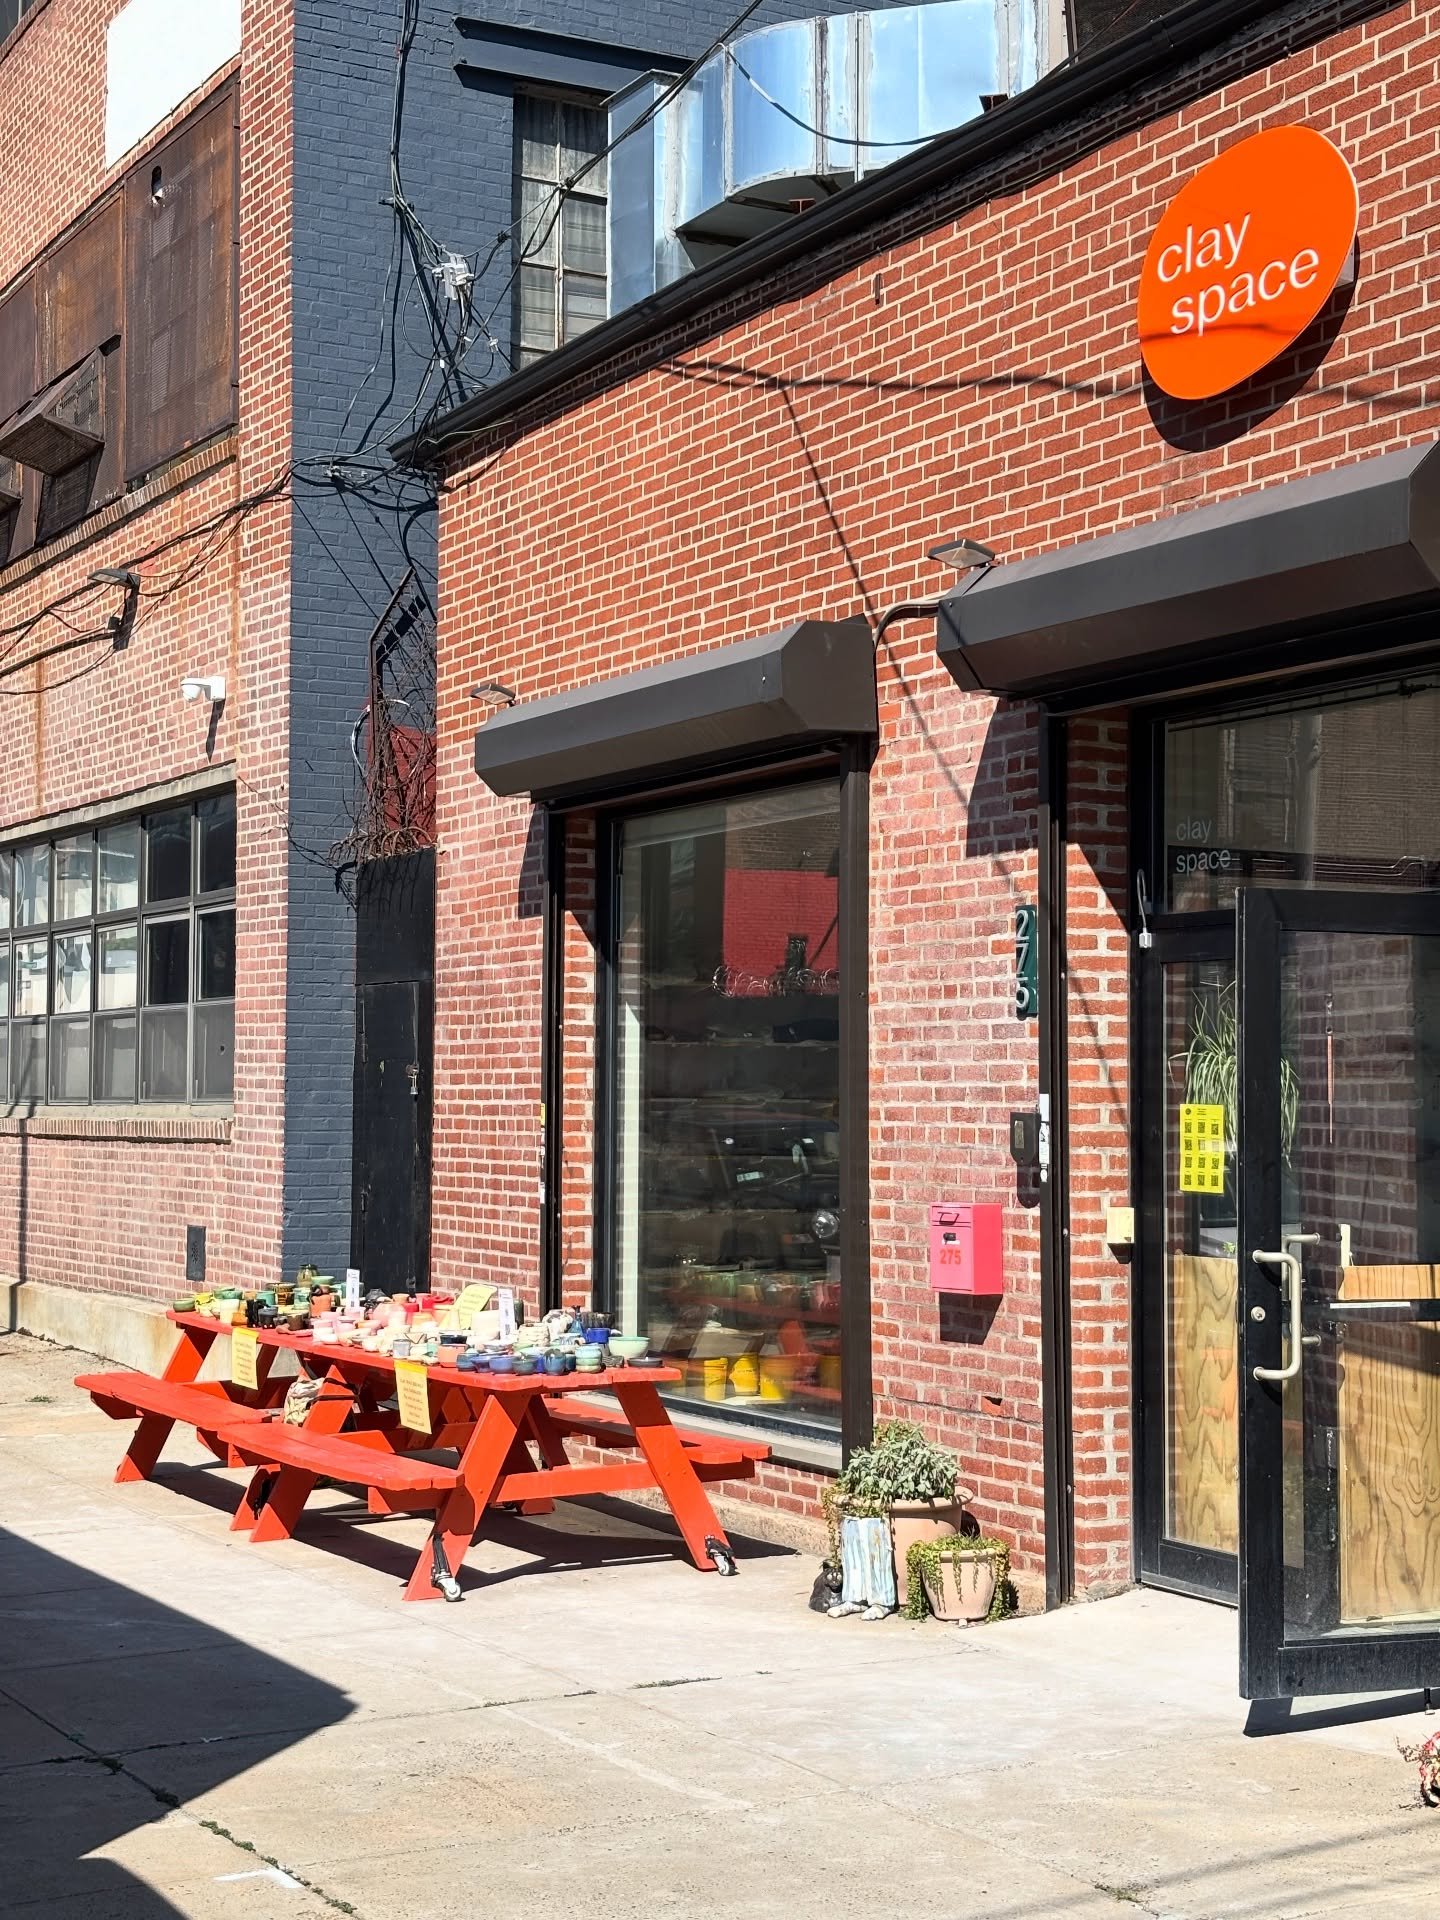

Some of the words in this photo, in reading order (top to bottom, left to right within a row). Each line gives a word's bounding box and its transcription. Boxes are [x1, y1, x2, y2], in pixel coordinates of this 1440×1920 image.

[1156, 213, 1250, 283] clay
[1170, 248, 1319, 336] space
[1176, 816, 1211, 842] clay
[1176, 850, 1231, 876] space
[1015, 909, 1030, 1009] 275
[940, 1248, 962, 1265] 275
